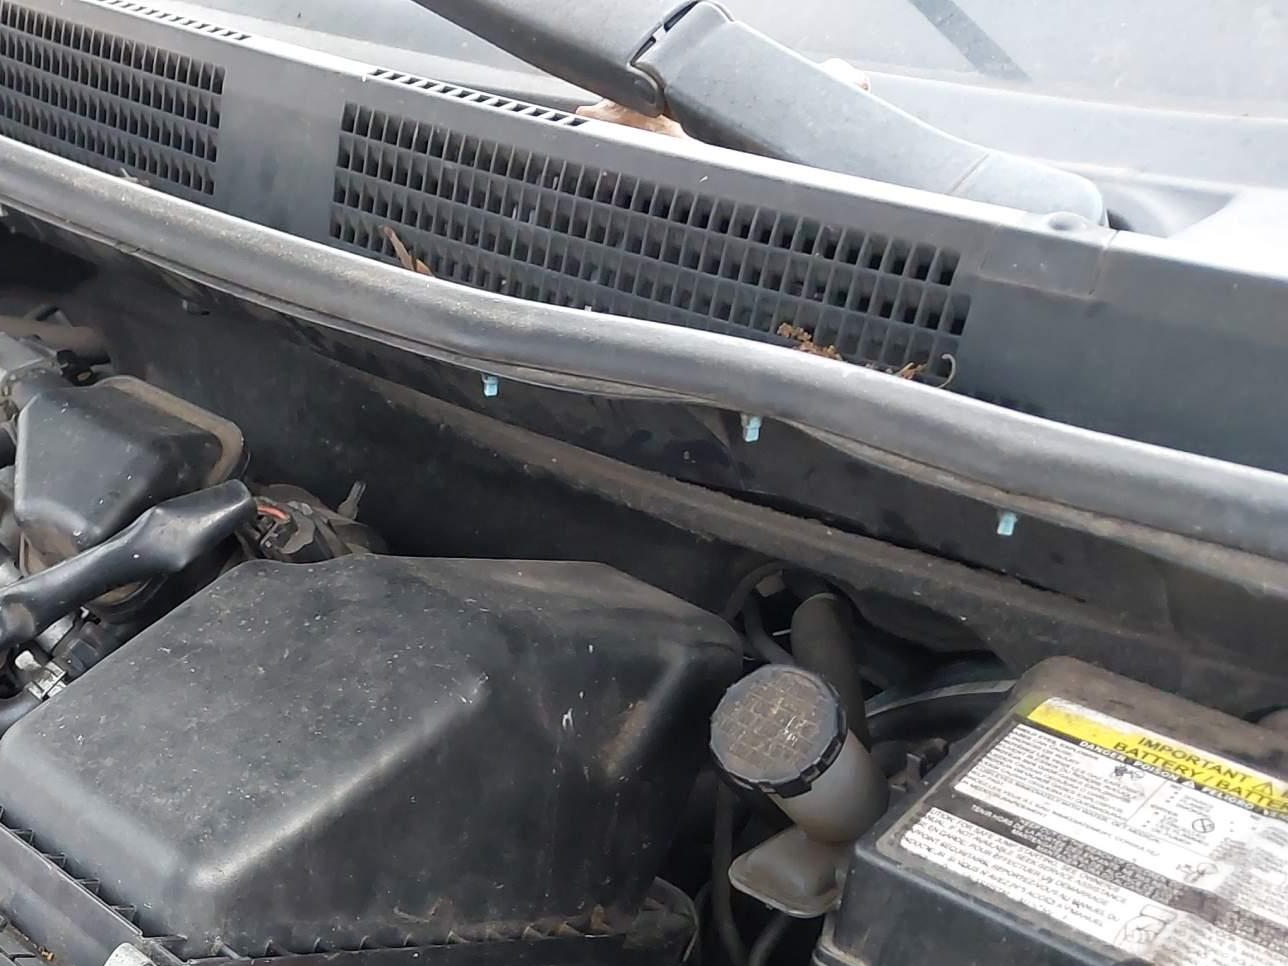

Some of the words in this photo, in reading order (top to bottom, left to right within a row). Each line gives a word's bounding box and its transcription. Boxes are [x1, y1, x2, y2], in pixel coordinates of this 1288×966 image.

[1078, 740, 1126, 762] DANGER
[1131, 759, 1180, 781] POISON
[1199, 786, 1255, 810] PELIGRO
[1112, 740, 1205, 781] BATTERY
[1138, 736, 1251, 784] IMPORTANT
